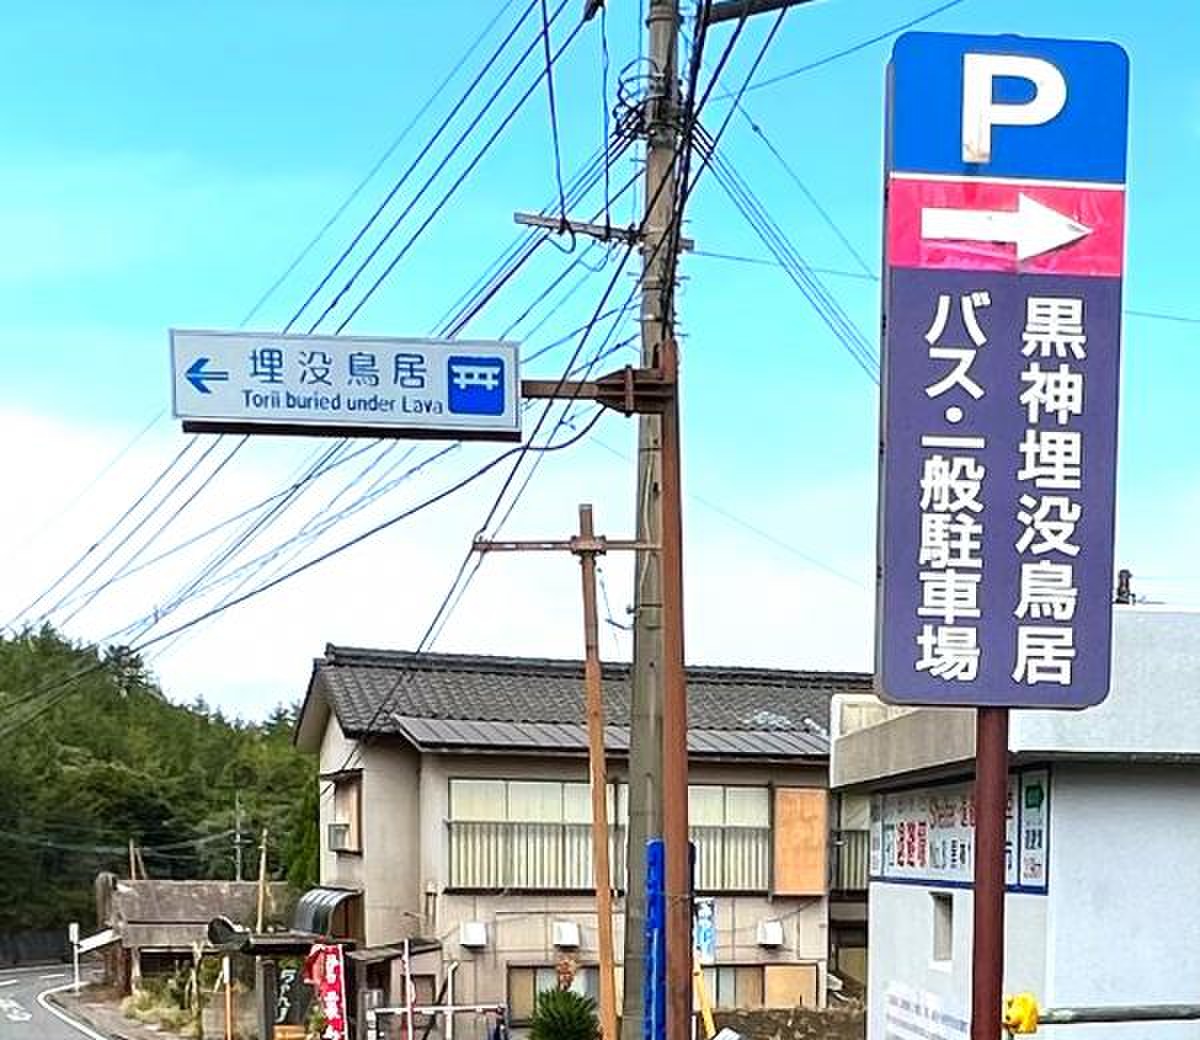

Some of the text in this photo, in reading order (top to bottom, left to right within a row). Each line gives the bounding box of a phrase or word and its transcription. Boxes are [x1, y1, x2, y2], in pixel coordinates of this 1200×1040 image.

[961, 52, 1067, 163] P
[241, 389, 443, 415] Torii buried under Lava
[248, 347, 428, 389] 埋没鳥居
[915, 290, 992, 681] バス・一般駐車場
[1011, 296, 1087, 686] 黒神埋没鳥居
